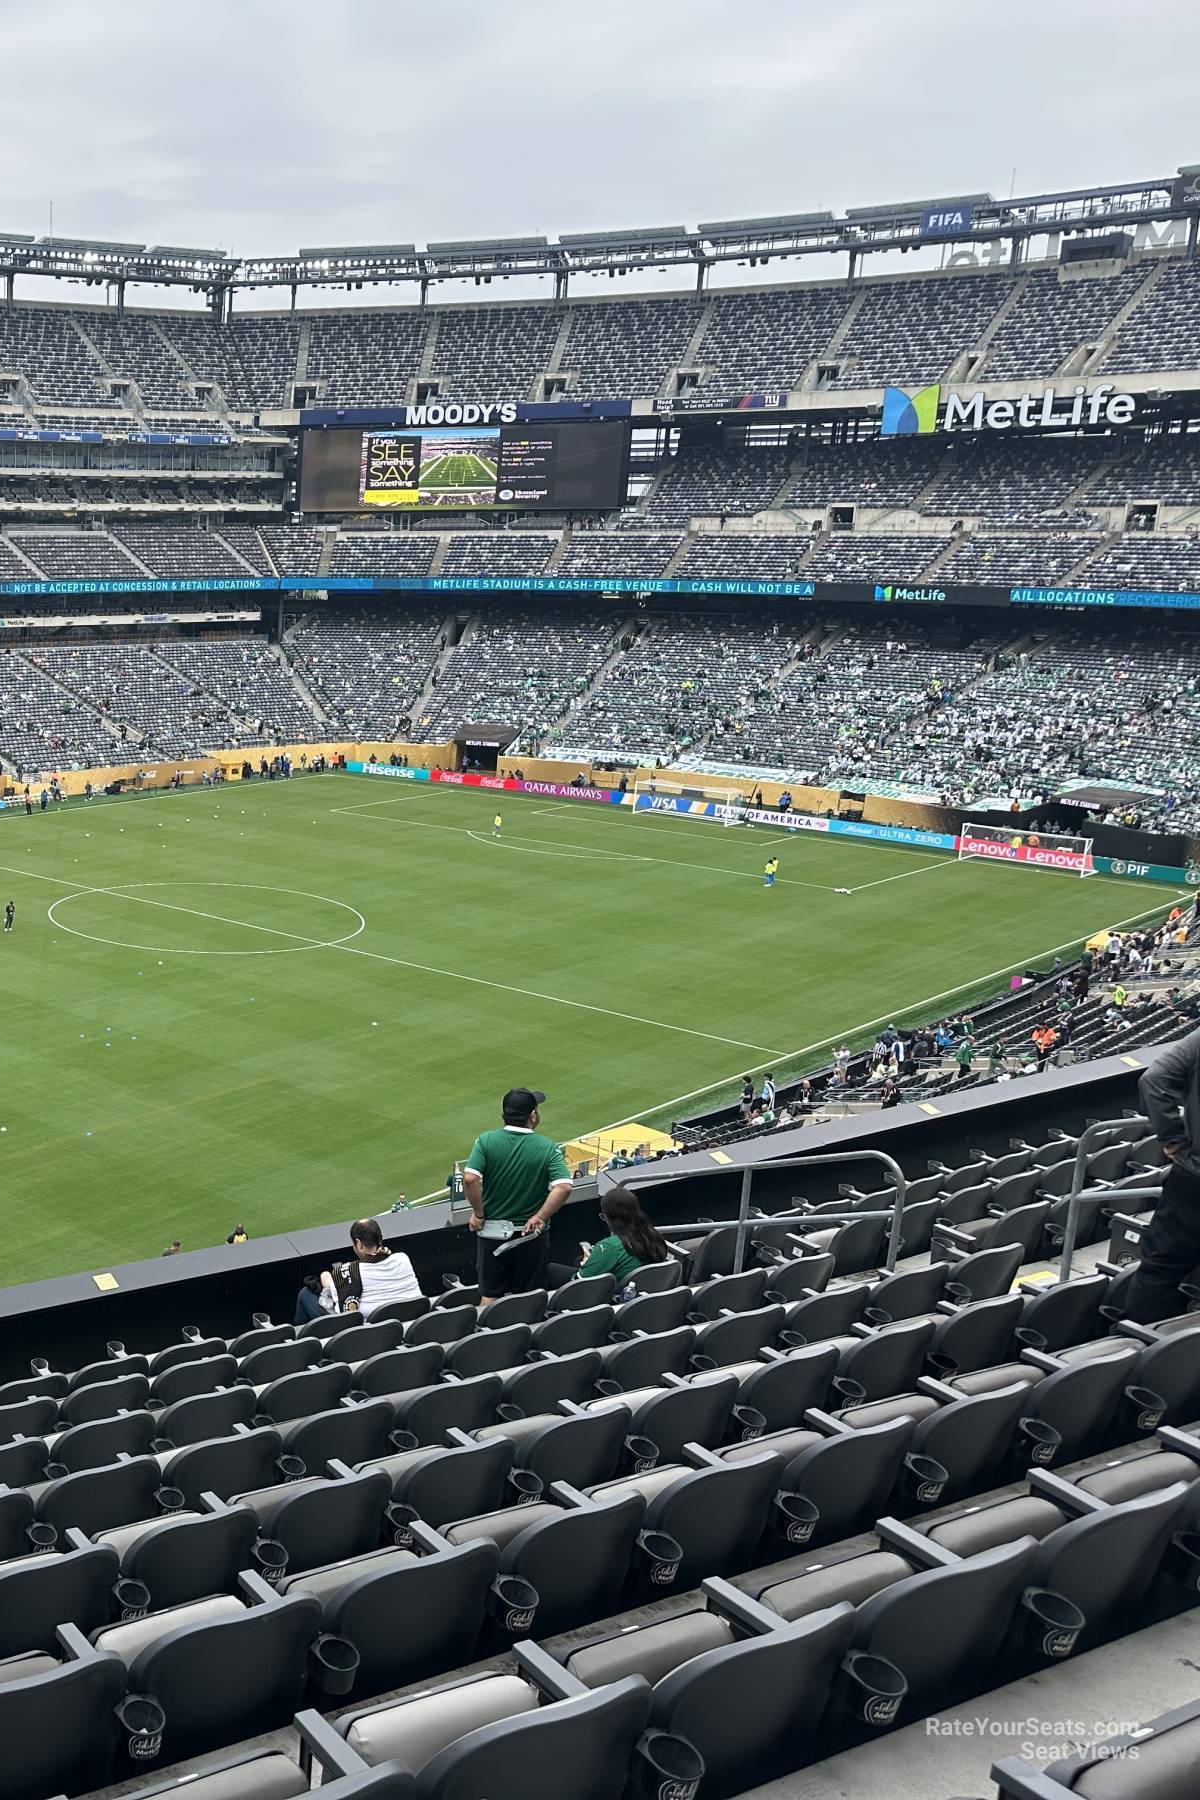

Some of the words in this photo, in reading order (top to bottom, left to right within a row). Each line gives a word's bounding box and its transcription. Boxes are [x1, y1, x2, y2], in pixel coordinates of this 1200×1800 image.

[928, 211, 964, 228] FIFA
[405, 403, 517, 425] MOODY'S
[944, 384, 1136, 430] MetLife
[371, 444, 415, 460] SEE
[369, 465, 416, 481] SAY
[14, 583, 31, 592] NOT
[34, 583, 47, 592] BE
[49, 582, 96, 592] ACCEPTED
[98, 582, 109, 591] AT
[112, 581, 167, 591] CONCESSION
[171, 582, 178, 590] &
[180, 581, 211, 589] RETAIL
[213, 580, 261, 589] LOCATIONS
[433, 579, 480, 590] METLIFE
[483, 580, 530, 590] STADIUM
[534, 581, 545, 590] IS
[548, 581, 556, 590] A
[558, 580, 621, 591] CASH-FREE
[625, 581, 663, 591] VENUE
[691, 581, 720, 592] CASH
[723, 581, 753, 593] WILL
[757, 582, 784, 593] NOT
[787, 583, 800, 594] BE
[895, 588, 946, 601] MetLife
[1011, 590, 1034, 601] AIL
[1038, 591, 1115, 604] LOCATIONS
[362, 762, 414, 778] Hisense
[524, 782, 557, 793] QATAR
[559, 785, 602, 799] AIRWAYS
[650, 796, 677, 809] VISA
[763, 813, 812, 827] AMERICA
[880, 829, 911, 840] ULTRA
[914, 834, 942, 845] ZERO
[1026, 849, 1085, 868] Lenovo
[1127, 864, 1150, 876] PIF
[455, 1182, 463, 1192] 76
